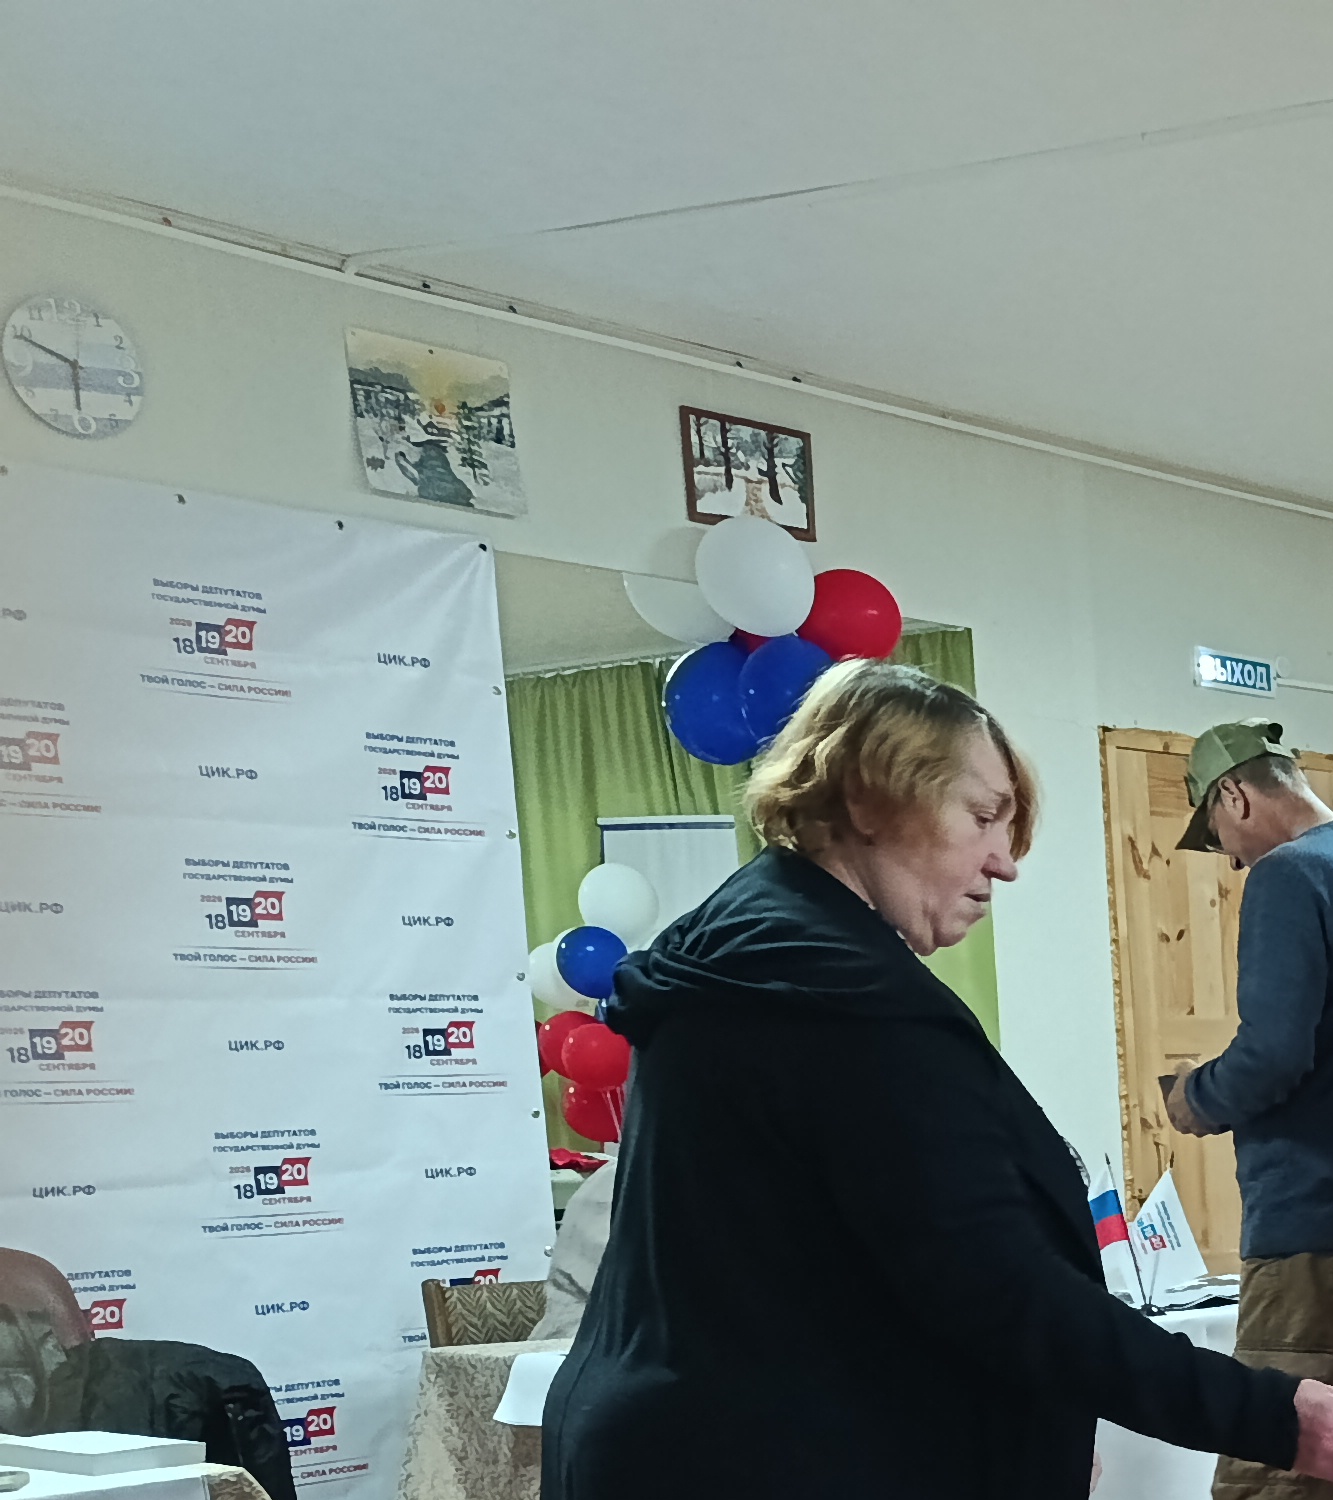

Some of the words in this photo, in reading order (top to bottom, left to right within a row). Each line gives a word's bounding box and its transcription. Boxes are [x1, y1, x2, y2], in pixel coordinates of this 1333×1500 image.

[114, 335, 126, 350] 2
[117, 356, 141, 388] 3
[153, 578, 199, 592] ВЫБОРЫ
[202, 585, 263, 600] ДЕПУТАТОВ
[198, 630, 220, 649] 19
[224, 625, 250, 643] 20
[173, 637, 196, 654] 18
[377, 652, 431, 668] ЦИК.РФ
[26, 738, 56, 758] 20
[365, 732, 404, 742] ВЫБОРЫ
[405, 736, 456, 747] ДЕПУТАТОВ
[0, 745, 23, 764] 19
[198, 765, 258, 780] ЦИК.РФ
[423, 771, 447, 789] 20
[381, 785, 400, 801] 18
[401, 777, 421, 794] 19
[185, 858, 230, 867] ВЫБОРЫ
[232, 861, 290, 871] ДЕПУТАТОВ
[229, 904, 251, 922] 19
[253, 897, 280, 914] 20
[205, 913, 226, 930] 18
[402, 915, 454, 927] ЦИК.РФ
[0, 989, 31, 999] БОРЫ
[389, 993, 426, 1001] ВЫБОРЫ
[428, 993, 479, 1001] ДЕПУТАТОВ
[60, 1027, 89, 1046] 20
[425, 1035, 445, 1051] 19
[447, 1027, 471, 1043] 20
[32, 1036, 58, 1055] 19
[228, 1039, 285, 1052] ЦИК.РФ
[405, 1044, 423, 1059] 18
[6, 1046, 31, 1064] 18
[214, 1130, 259, 1139] ВЫБОРЫ
[260, 1128, 317, 1139] ДЕПУТАТОВ
[281, 1163, 306, 1181] 20
[424, 1166, 477, 1179] ЦИК.РФ
[256, 1172, 279, 1190] 19
[32, 1185, 96, 1199] ЦИК.РФ
[233, 1183, 255, 1200] 18
[67, 1269, 132, 1280] ДЕПУТАТОВ
[91, 1306, 120, 1324] 20
[254, 1300, 310, 1316] ЦИК.РФ
[402, 1332, 427, 1343] ТВОЙ
[307, 1413, 332, 1432] 20
[283, 1425, 305, 1442] 19
